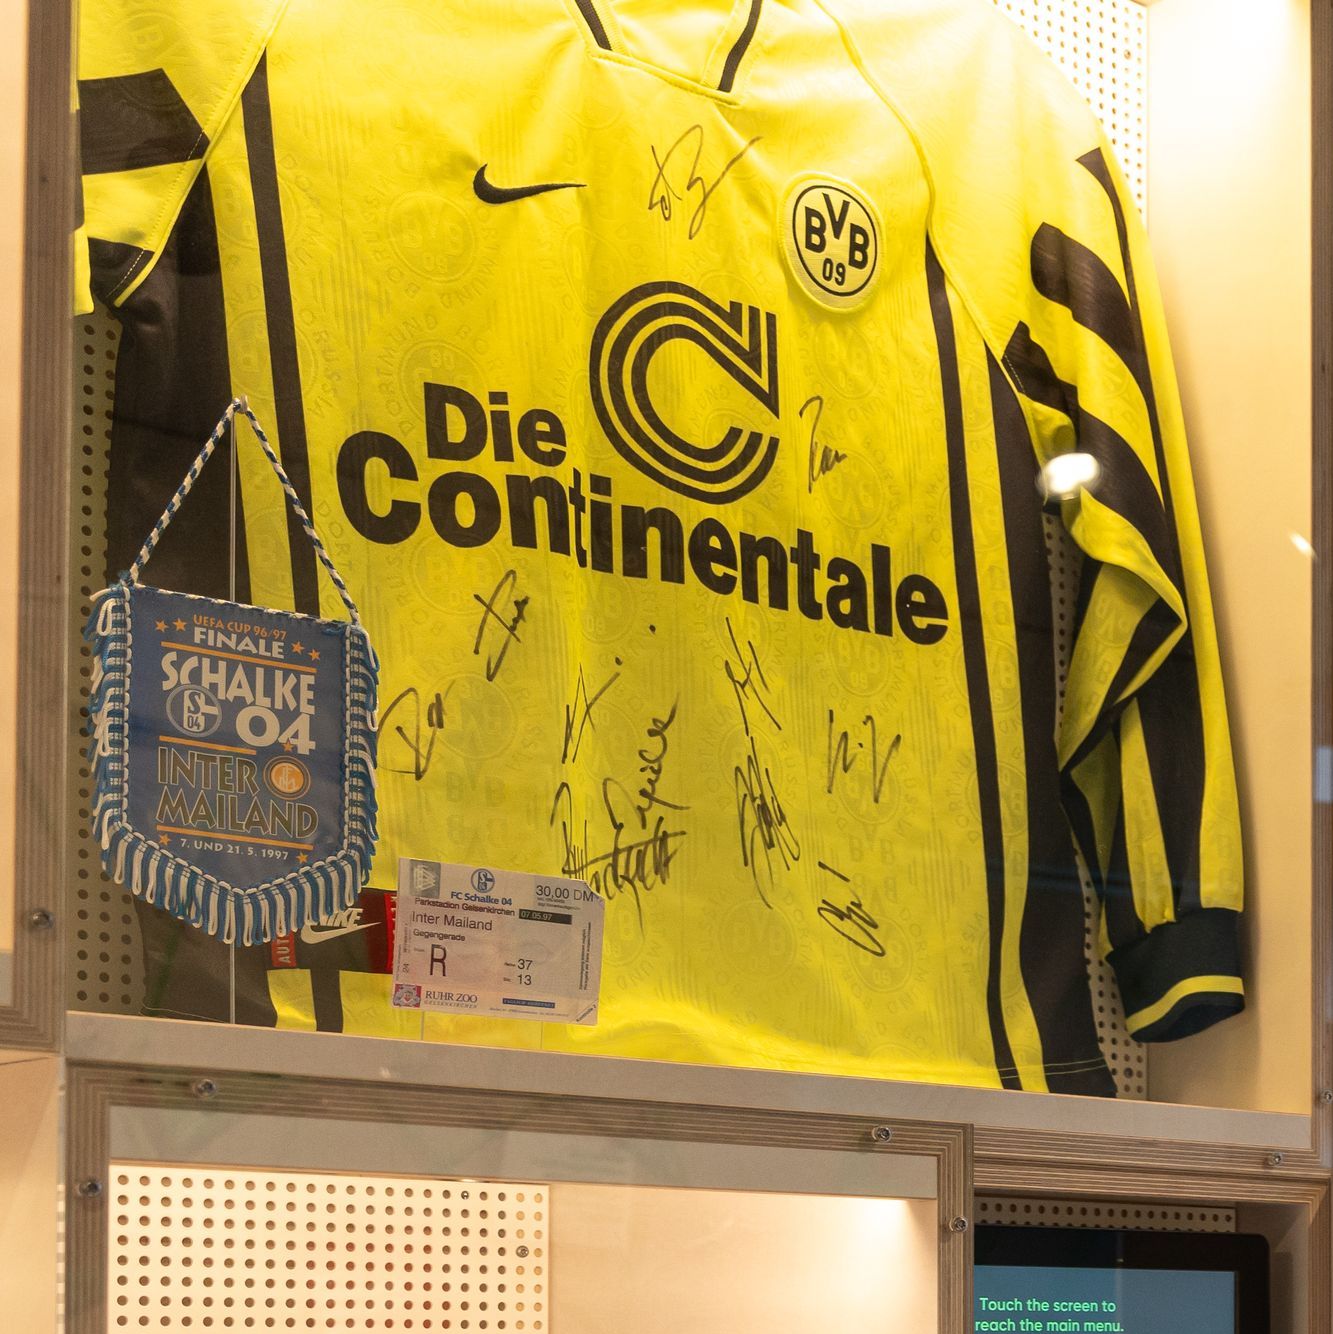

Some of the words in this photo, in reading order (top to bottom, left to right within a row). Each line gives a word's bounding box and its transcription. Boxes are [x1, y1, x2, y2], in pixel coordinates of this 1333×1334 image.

[804, 192, 870, 270] BVB
[822, 257, 846, 286] 09
[424, 381, 567, 467] Die
[336, 430, 949, 645] Continentale
[193, 614, 224, 630] UEFA
[226, 621, 251, 633] CUP
[253, 625, 287, 640] 96/97
[193, 627, 285, 659] FINALE
[161, 651, 316, 715] SCHALKE
[236, 705, 316, 755] 04
[158, 746, 261, 797] INTER
[155, 785, 319, 839] MAILAND
[180, 838, 190, 849] 7.
[193, 840, 223, 852] UND
[227, 844, 244, 854] 21.
[247, 847, 257, 857] 5.
[261, 849, 289, 861] 1997
[451, 891, 463, 900] FC
[464, 892, 499, 905] Schalke
[501, 897, 513, 906] 04
[535, 885, 570, 899] 30,00
[573, 889, 594, 902] DM
[412, 911, 440, 925] Inter
[443, 914, 493, 931] Mailand
[429, 943, 447, 977] R
[517, 958, 533, 970] 37
[517, 973, 532, 986] 13
[425, 990, 454, 1001] RUHR
[456, 992, 478, 1003] ZOO
[979, 1297, 1023, 1311] Touch
[1026, 1298, 1050, 1312] the
[1053, 1300, 1099, 1312] screen
[1102, 1300, 1116, 1312] to
[975, 1318, 1016, 1332] reach
[1019, 1318, 1043, 1332] the
[1046, 1319, 1080, 1332] main
[1083, 1322, 1124, 1332] menu.
